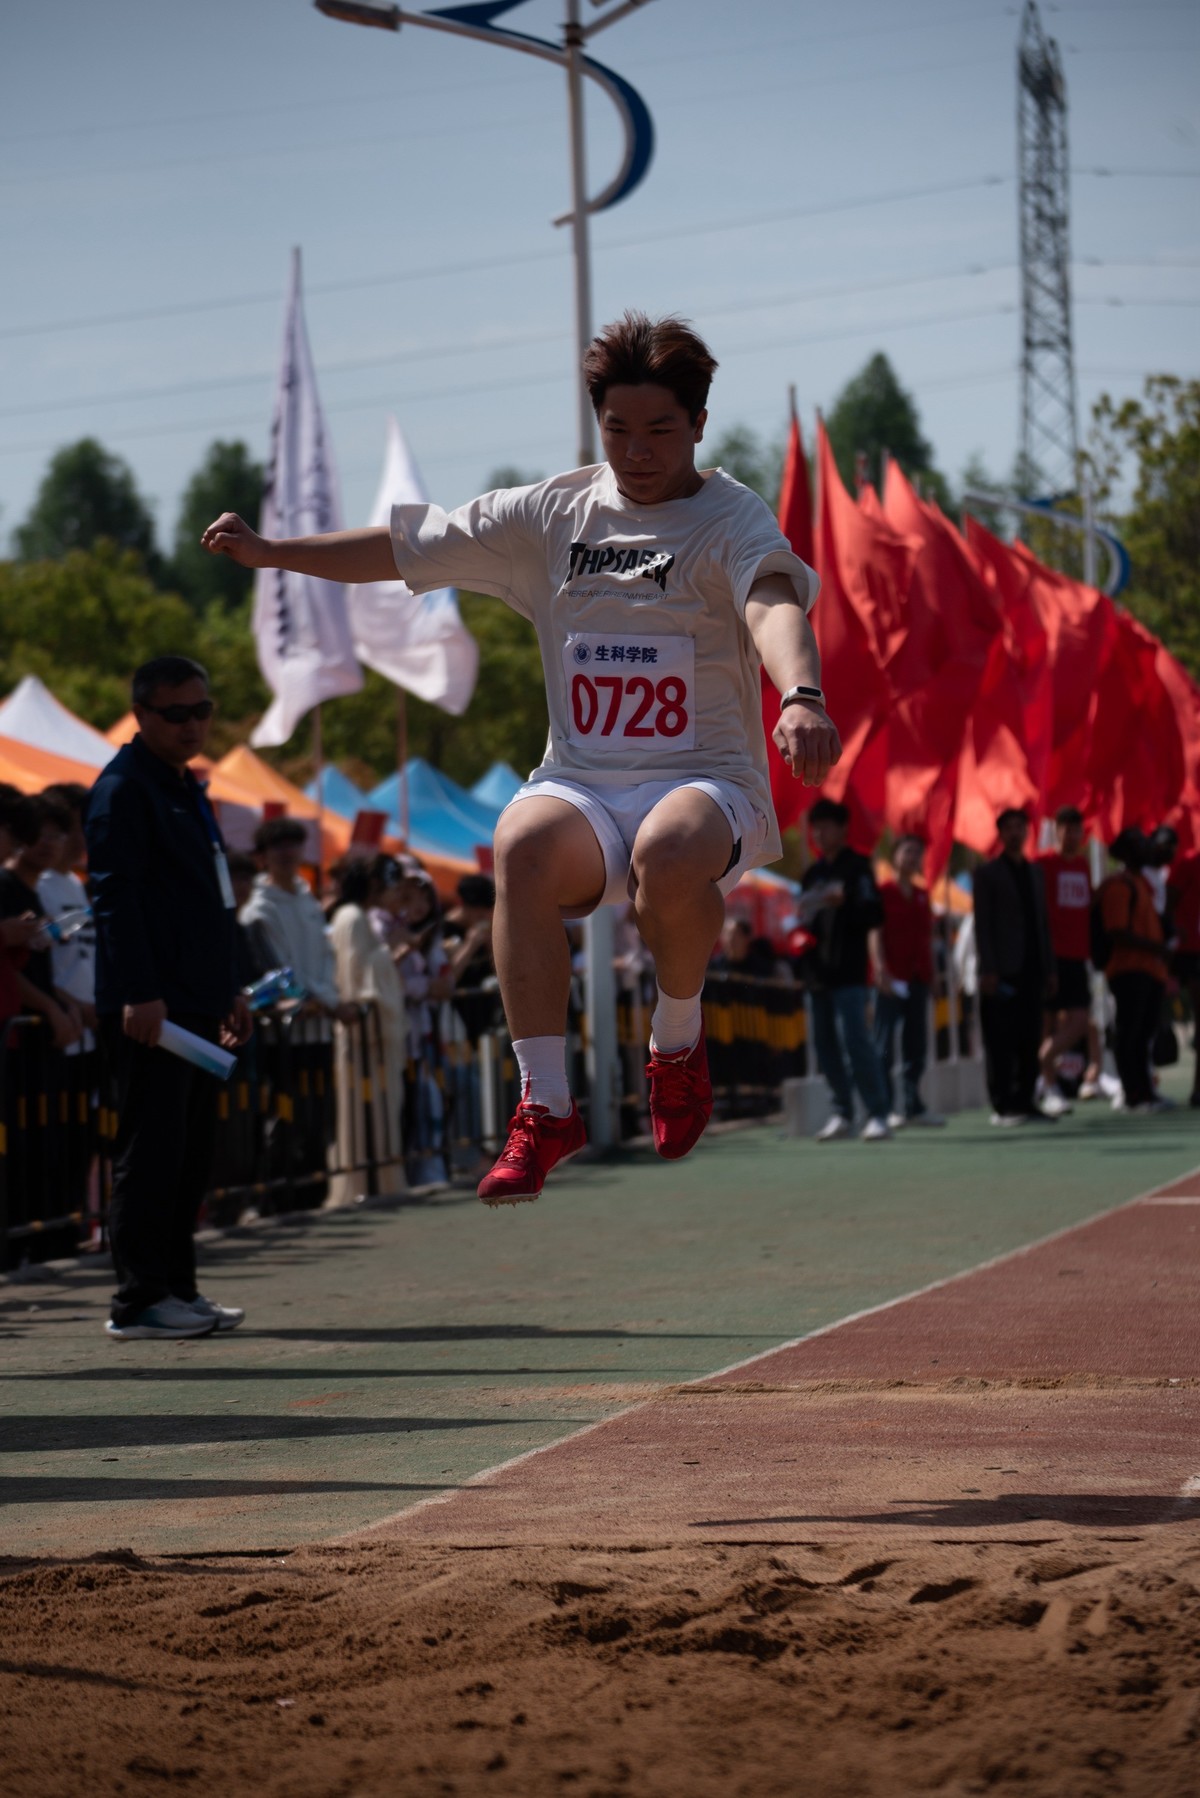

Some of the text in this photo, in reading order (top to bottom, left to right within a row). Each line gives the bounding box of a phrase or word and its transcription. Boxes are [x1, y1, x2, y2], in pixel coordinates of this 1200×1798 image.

[595, 645, 657, 663] 生科学院
[572, 674, 688, 737] 0728
